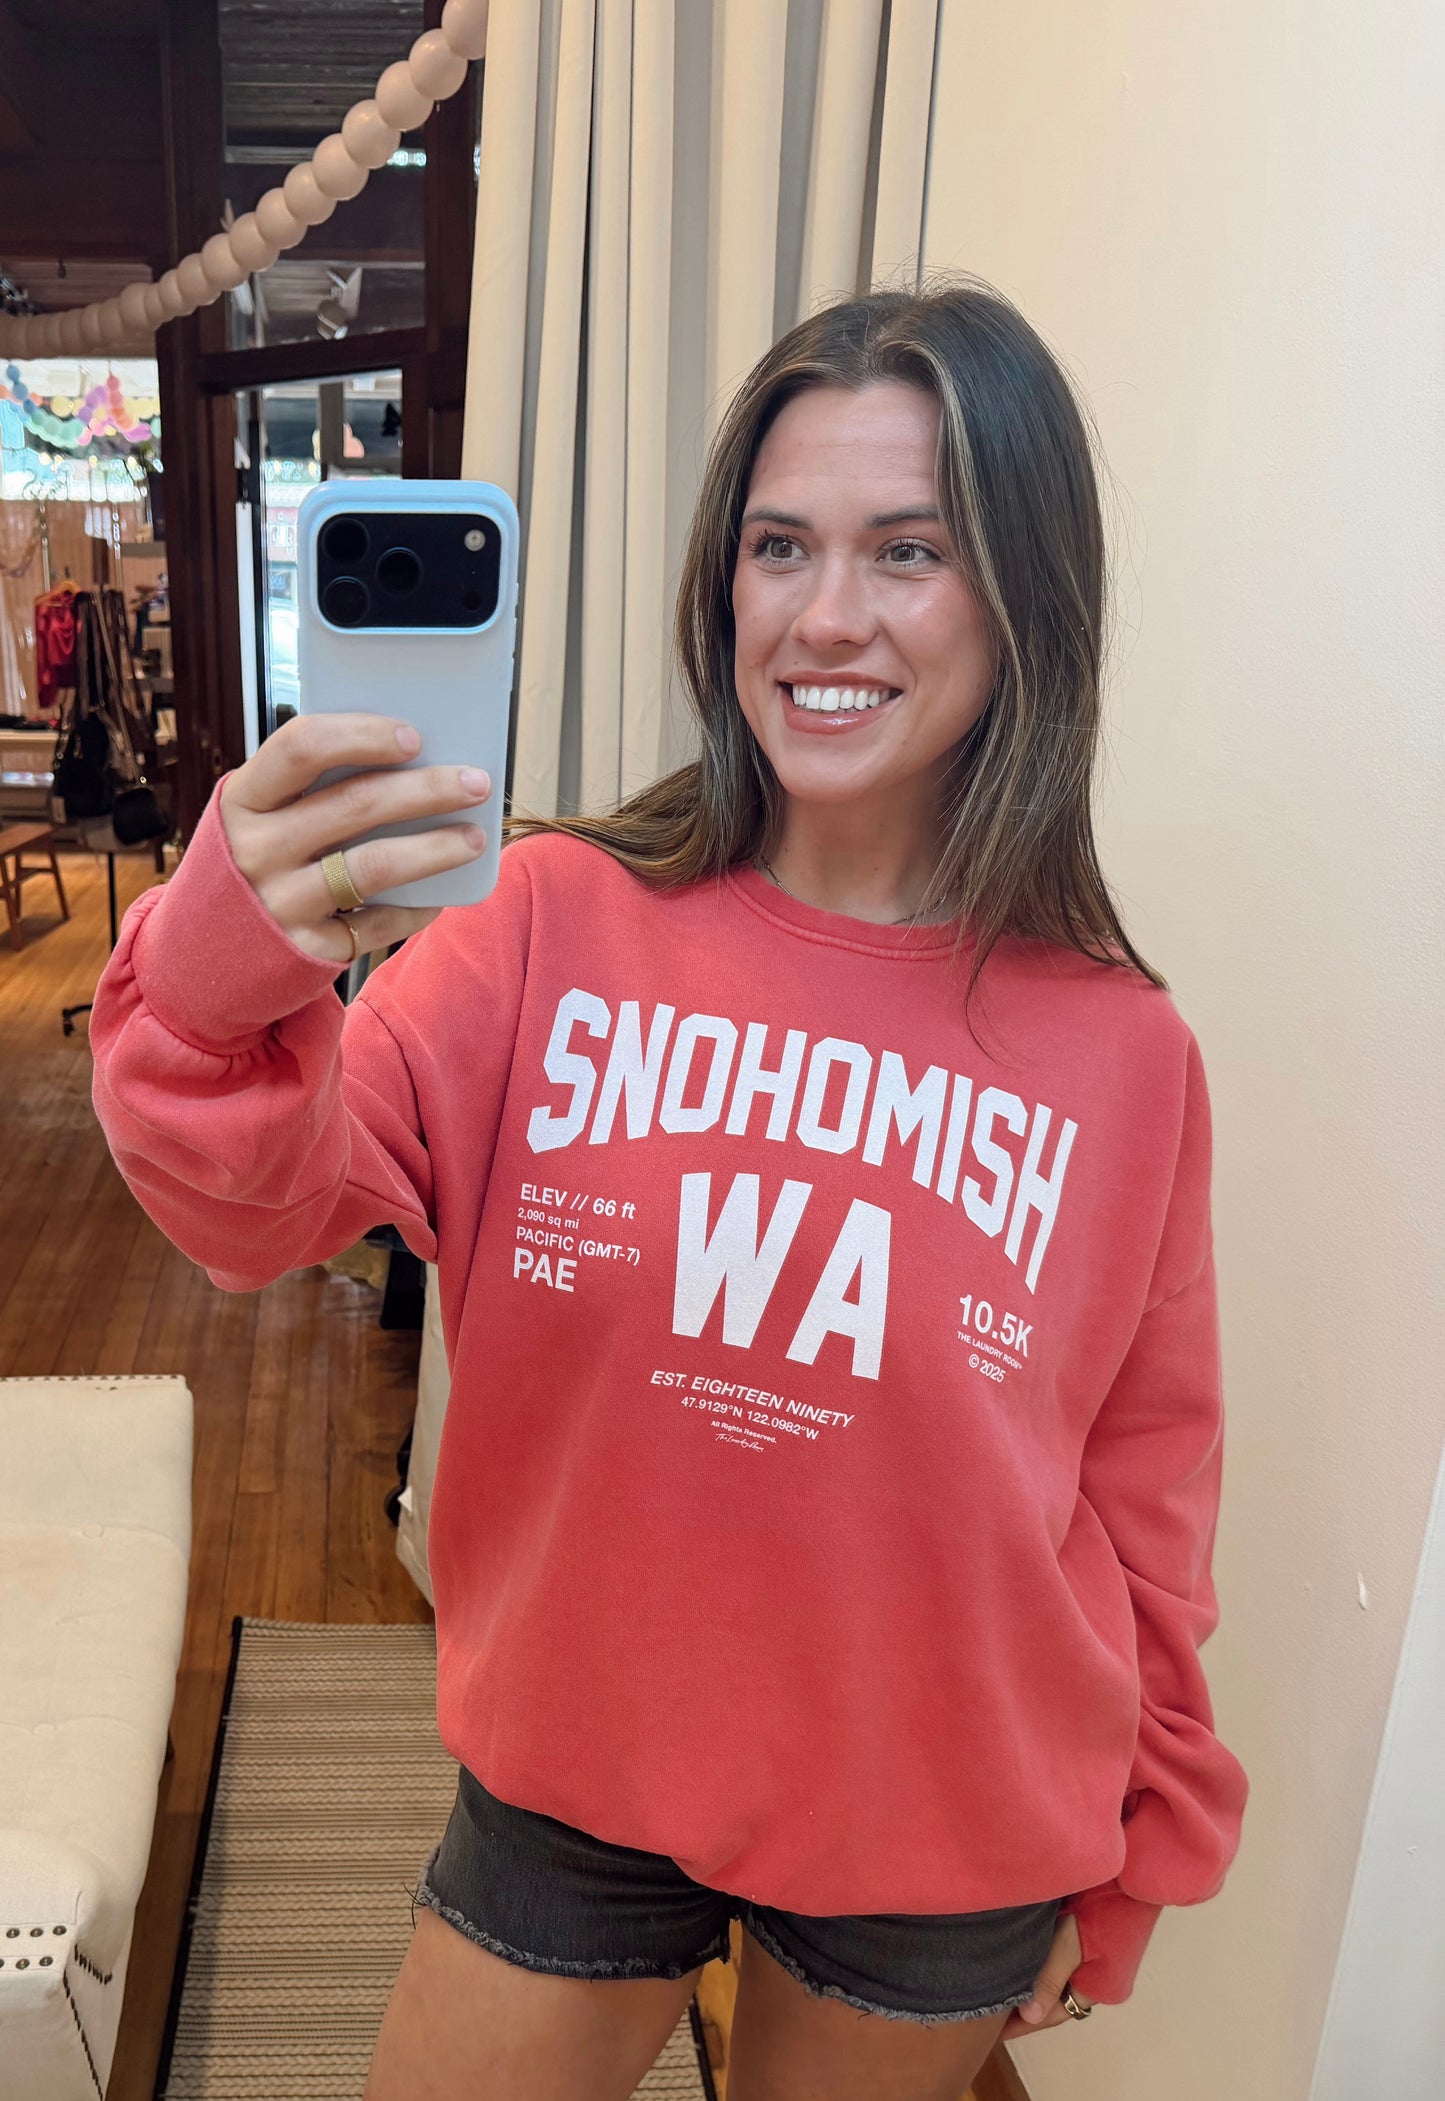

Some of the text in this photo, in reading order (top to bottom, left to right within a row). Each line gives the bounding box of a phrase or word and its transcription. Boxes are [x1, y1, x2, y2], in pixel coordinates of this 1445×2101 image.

[526, 987, 1078, 1295] SNOHOMISH
[517, 1207, 580, 1229] 2,090 sq mi
[520, 1183, 636, 1219] ELEV // 66 ft
[516, 1226, 641, 1266] PACIFIC (GMT-7)
[513, 1247, 578, 1293] PAE
[672, 1172, 892, 1380] WA
[957, 1330, 971, 1344] THE
[972, 1338, 1003, 1359] LAUNDRY
[960, 1294, 1034, 1358] 10.5K
[980, 1359, 1006, 1383] 2025
[650, 1370, 855, 1428] EST. EIGHTEEN NINETY
[681, 1396, 819, 1441] 47.9129°N 122.0982°W
[711, 1420, 777, 1444] All Rights Reserved.
